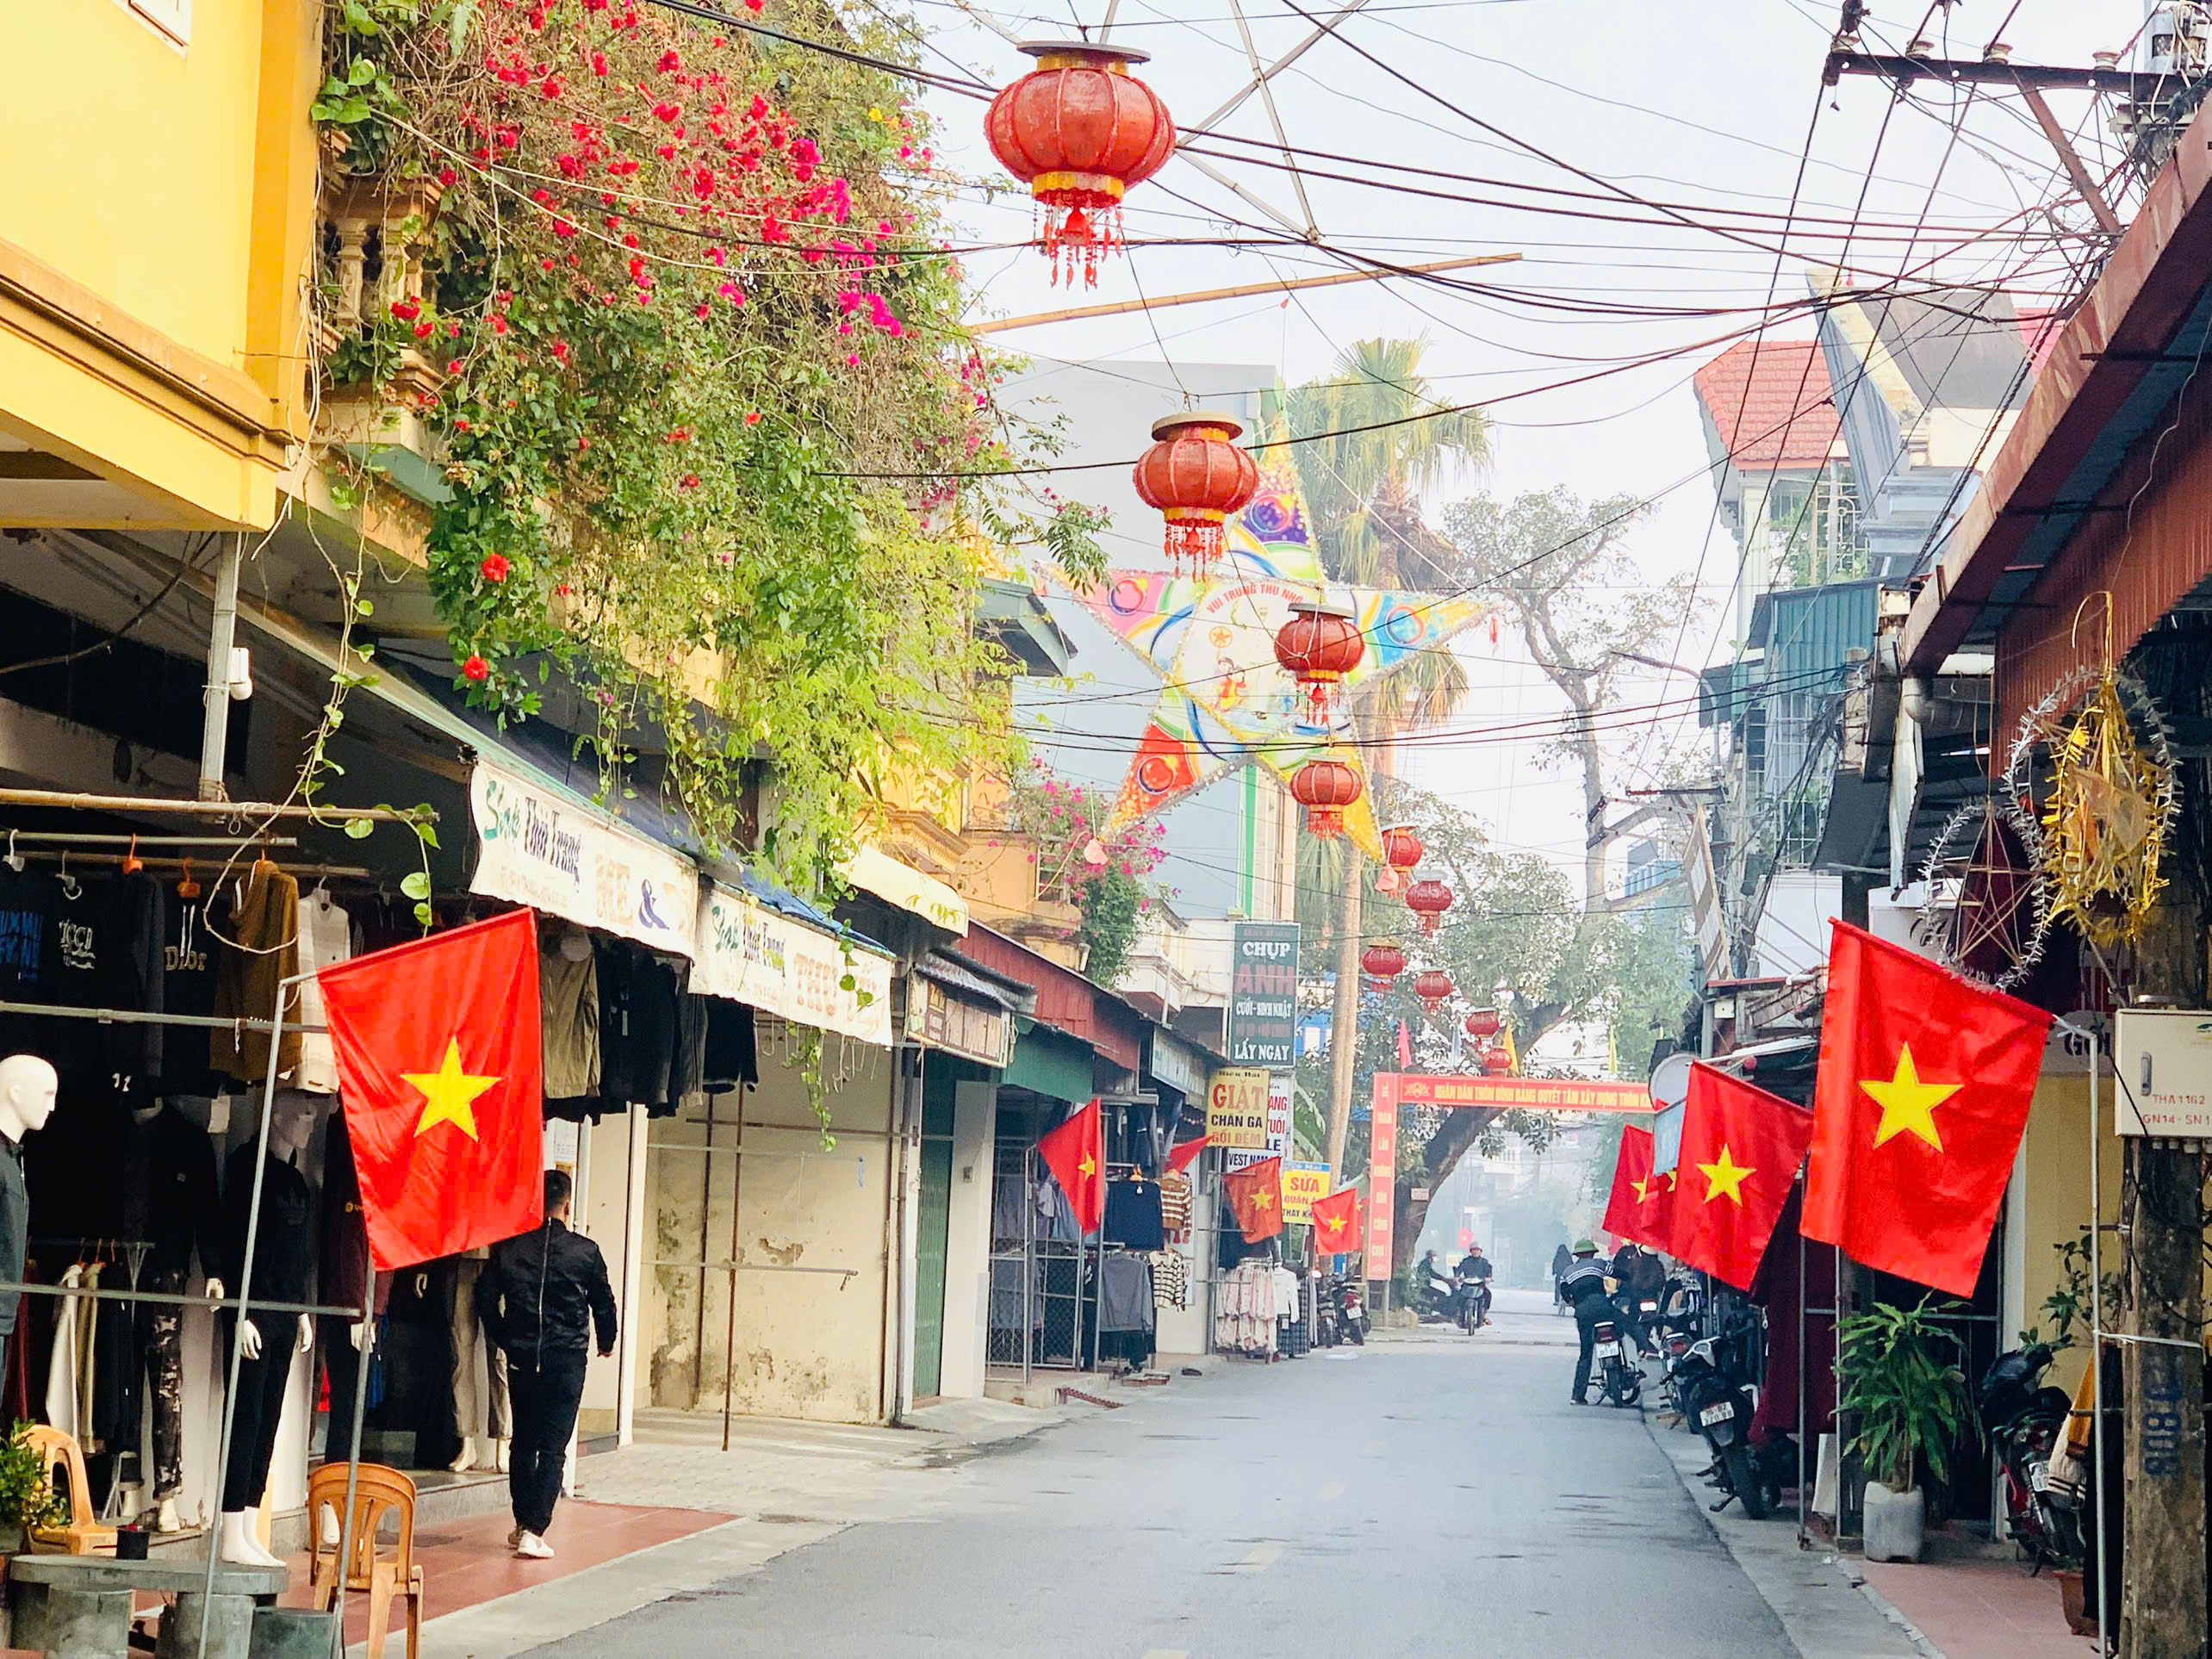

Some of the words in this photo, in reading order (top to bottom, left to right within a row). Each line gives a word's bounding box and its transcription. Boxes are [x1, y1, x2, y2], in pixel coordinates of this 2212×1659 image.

[1206, 597, 1223, 613] VUI
[1260, 584, 1280, 595] THU
[1242, 941, 1291, 960] CHỤP
[1234, 1037, 1257, 1060] LẤY
[1258, 1044, 1289, 1061] NGAY
[1212, 1078, 1264, 1113] GIẶT
[1267, 1096, 1288, 1111] ANG
[1211, 1114, 1243, 1127] CHĂN
[1247, 1116, 1263, 1128] GA
[1228, 1153, 1248, 1166] VEST
[1289, 1173, 1320, 1192] SỬA
